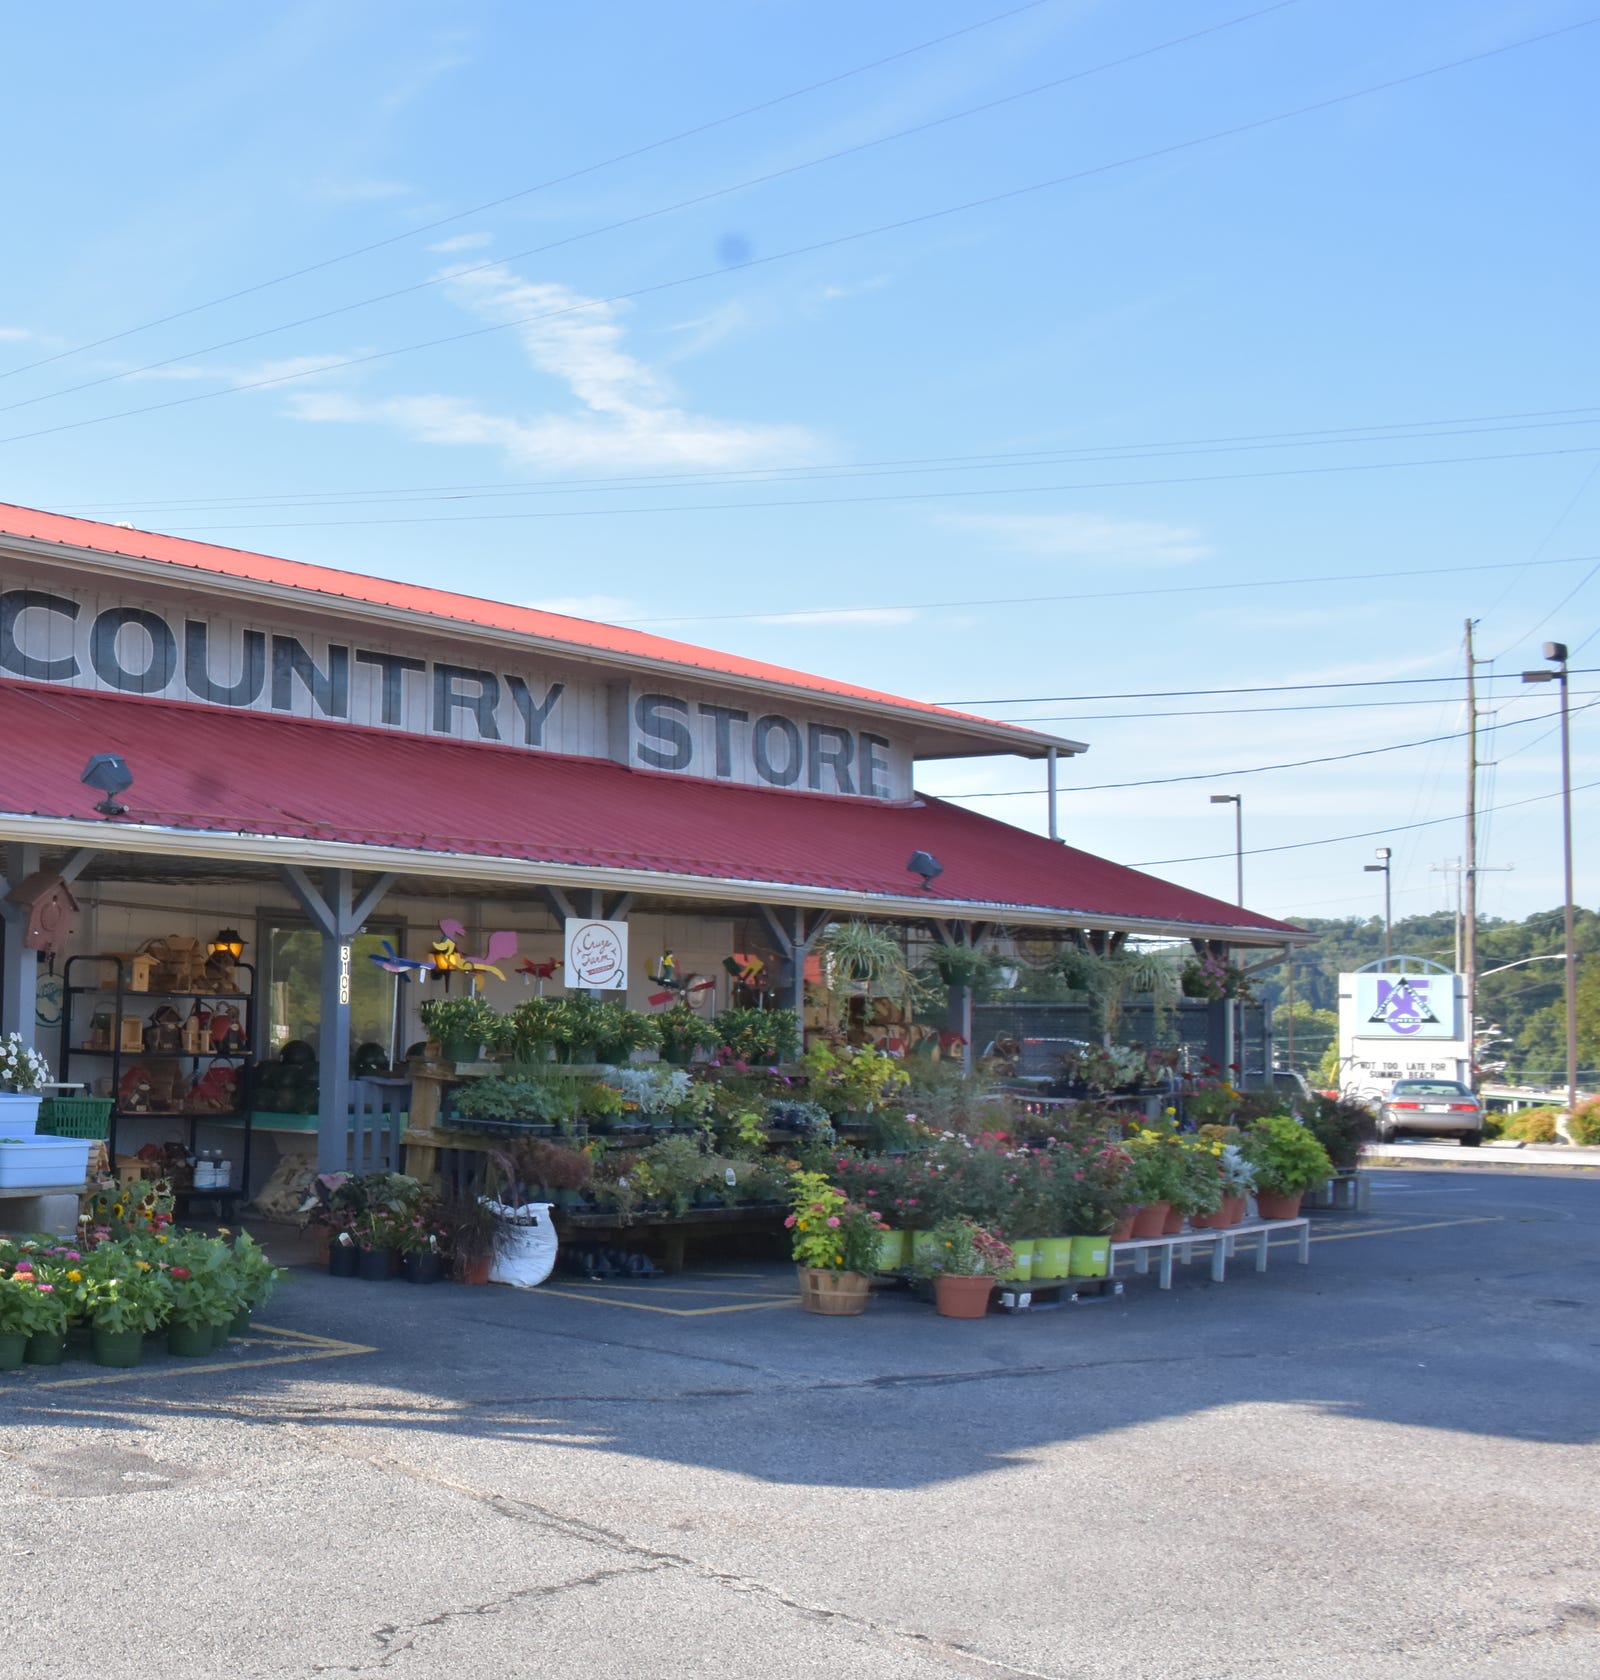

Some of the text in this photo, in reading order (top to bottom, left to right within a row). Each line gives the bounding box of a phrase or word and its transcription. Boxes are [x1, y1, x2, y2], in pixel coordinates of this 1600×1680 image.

[634, 693, 890, 799] STORE
[341, 947, 349, 1003] 3100
[1369, 1071, 1403, 1079] SUMMER
[1383, 1062, 1398, 1070] TOO
[1406, 1062, 1425, 1070] LATE
[1431, 1063, 1446, 1071] FOR
